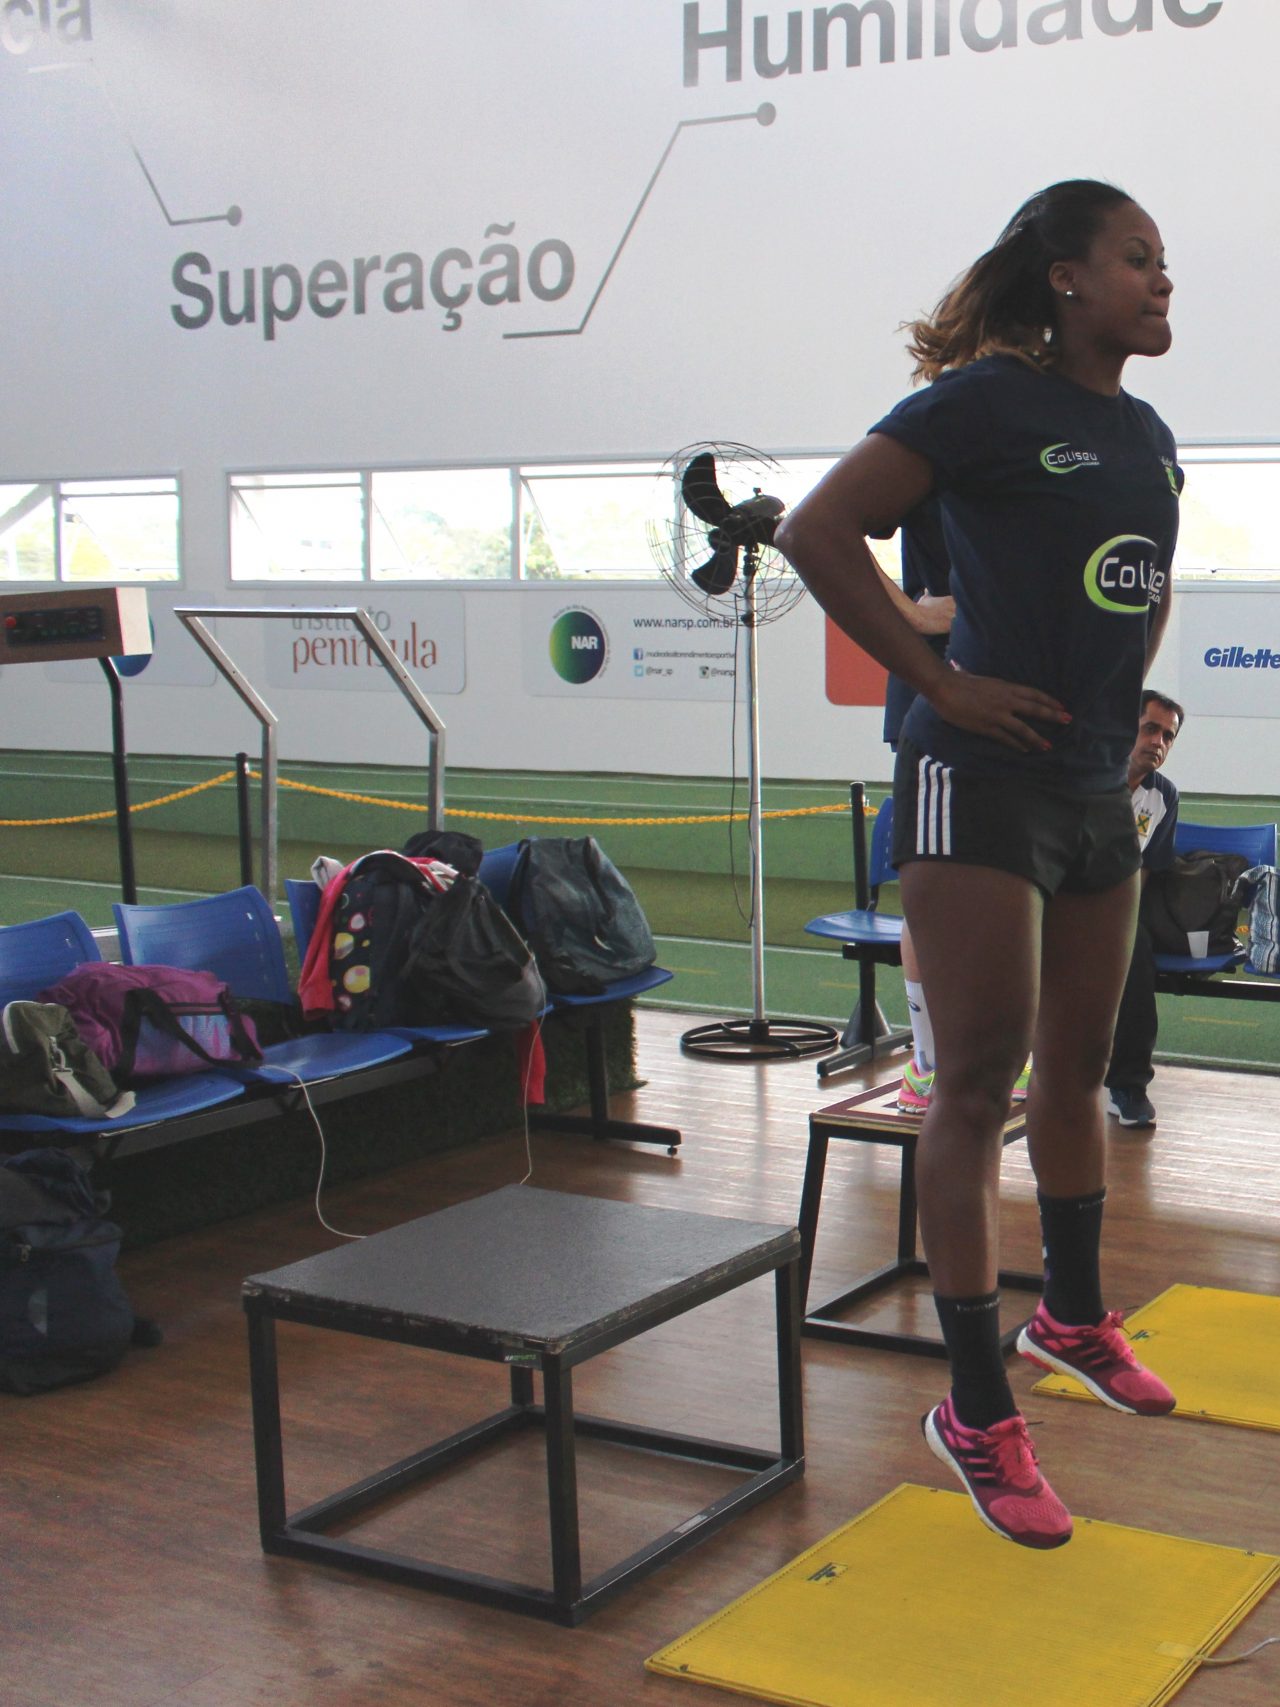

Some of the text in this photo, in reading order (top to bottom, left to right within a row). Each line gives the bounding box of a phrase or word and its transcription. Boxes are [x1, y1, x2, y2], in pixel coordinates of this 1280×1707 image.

[170, 222, 576, 341] Superação
[1046, 451, 1098, 465] Coliseu
[633, 618, 734, 630] www.narsp.com.br
[293, 622, 437, 674] peninula
[571, 635, 598, 650] NAR
